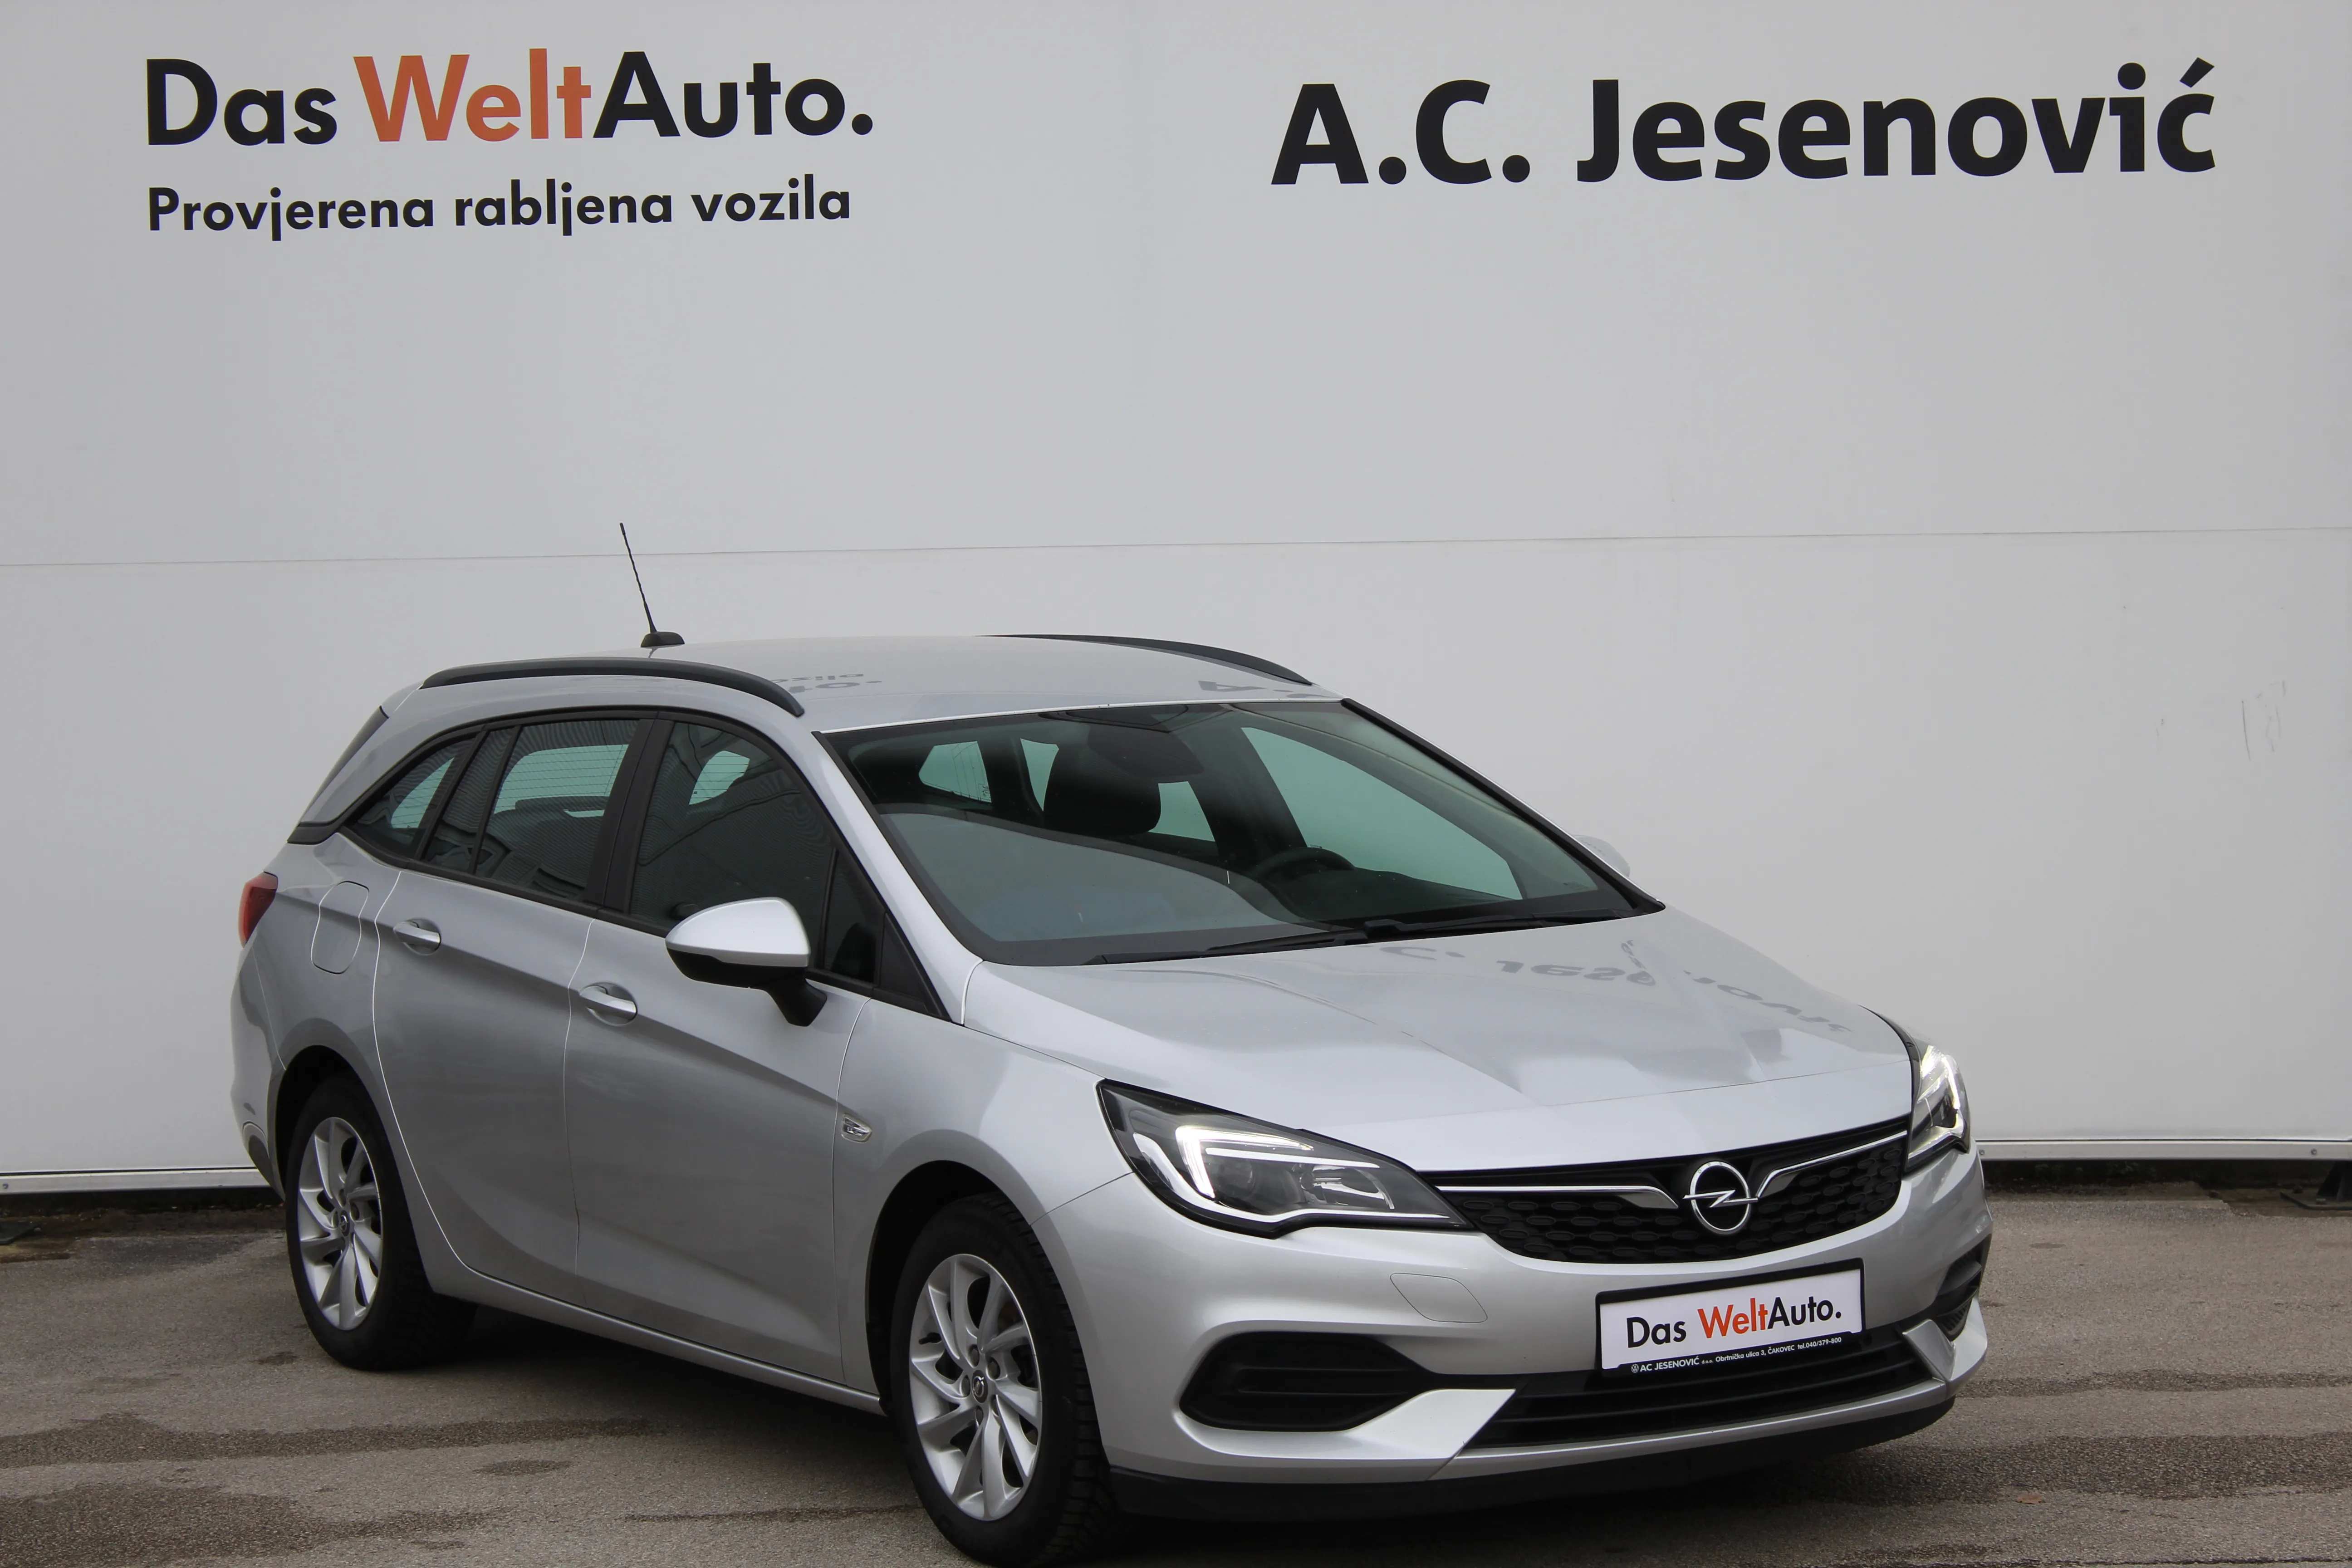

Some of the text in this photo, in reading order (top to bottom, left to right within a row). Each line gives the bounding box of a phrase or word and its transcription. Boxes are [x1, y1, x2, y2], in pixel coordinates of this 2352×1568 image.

[147, 48, 873, 146] Das WeltAuto.
[1271, 57, 2215, 185] A.C. Jesenović
[149, 173, 850, 241] Provjerena rabljena vozila
[1627, 1296, 1842, 1348] Das WeltAuto.
[1640, 1364, 1652, 1372] AC
[1654, 1356, 1700, 1370] JESENOVIĆ
[1715, 1353, 1744, 1362] Obrtnička
[1746, 1350, 1759, 1358] ulica
[1768, 1344, 1795, 1355] ČAKOVEC
[1798, 1337, 1842, 1350] tel.040/379-800
